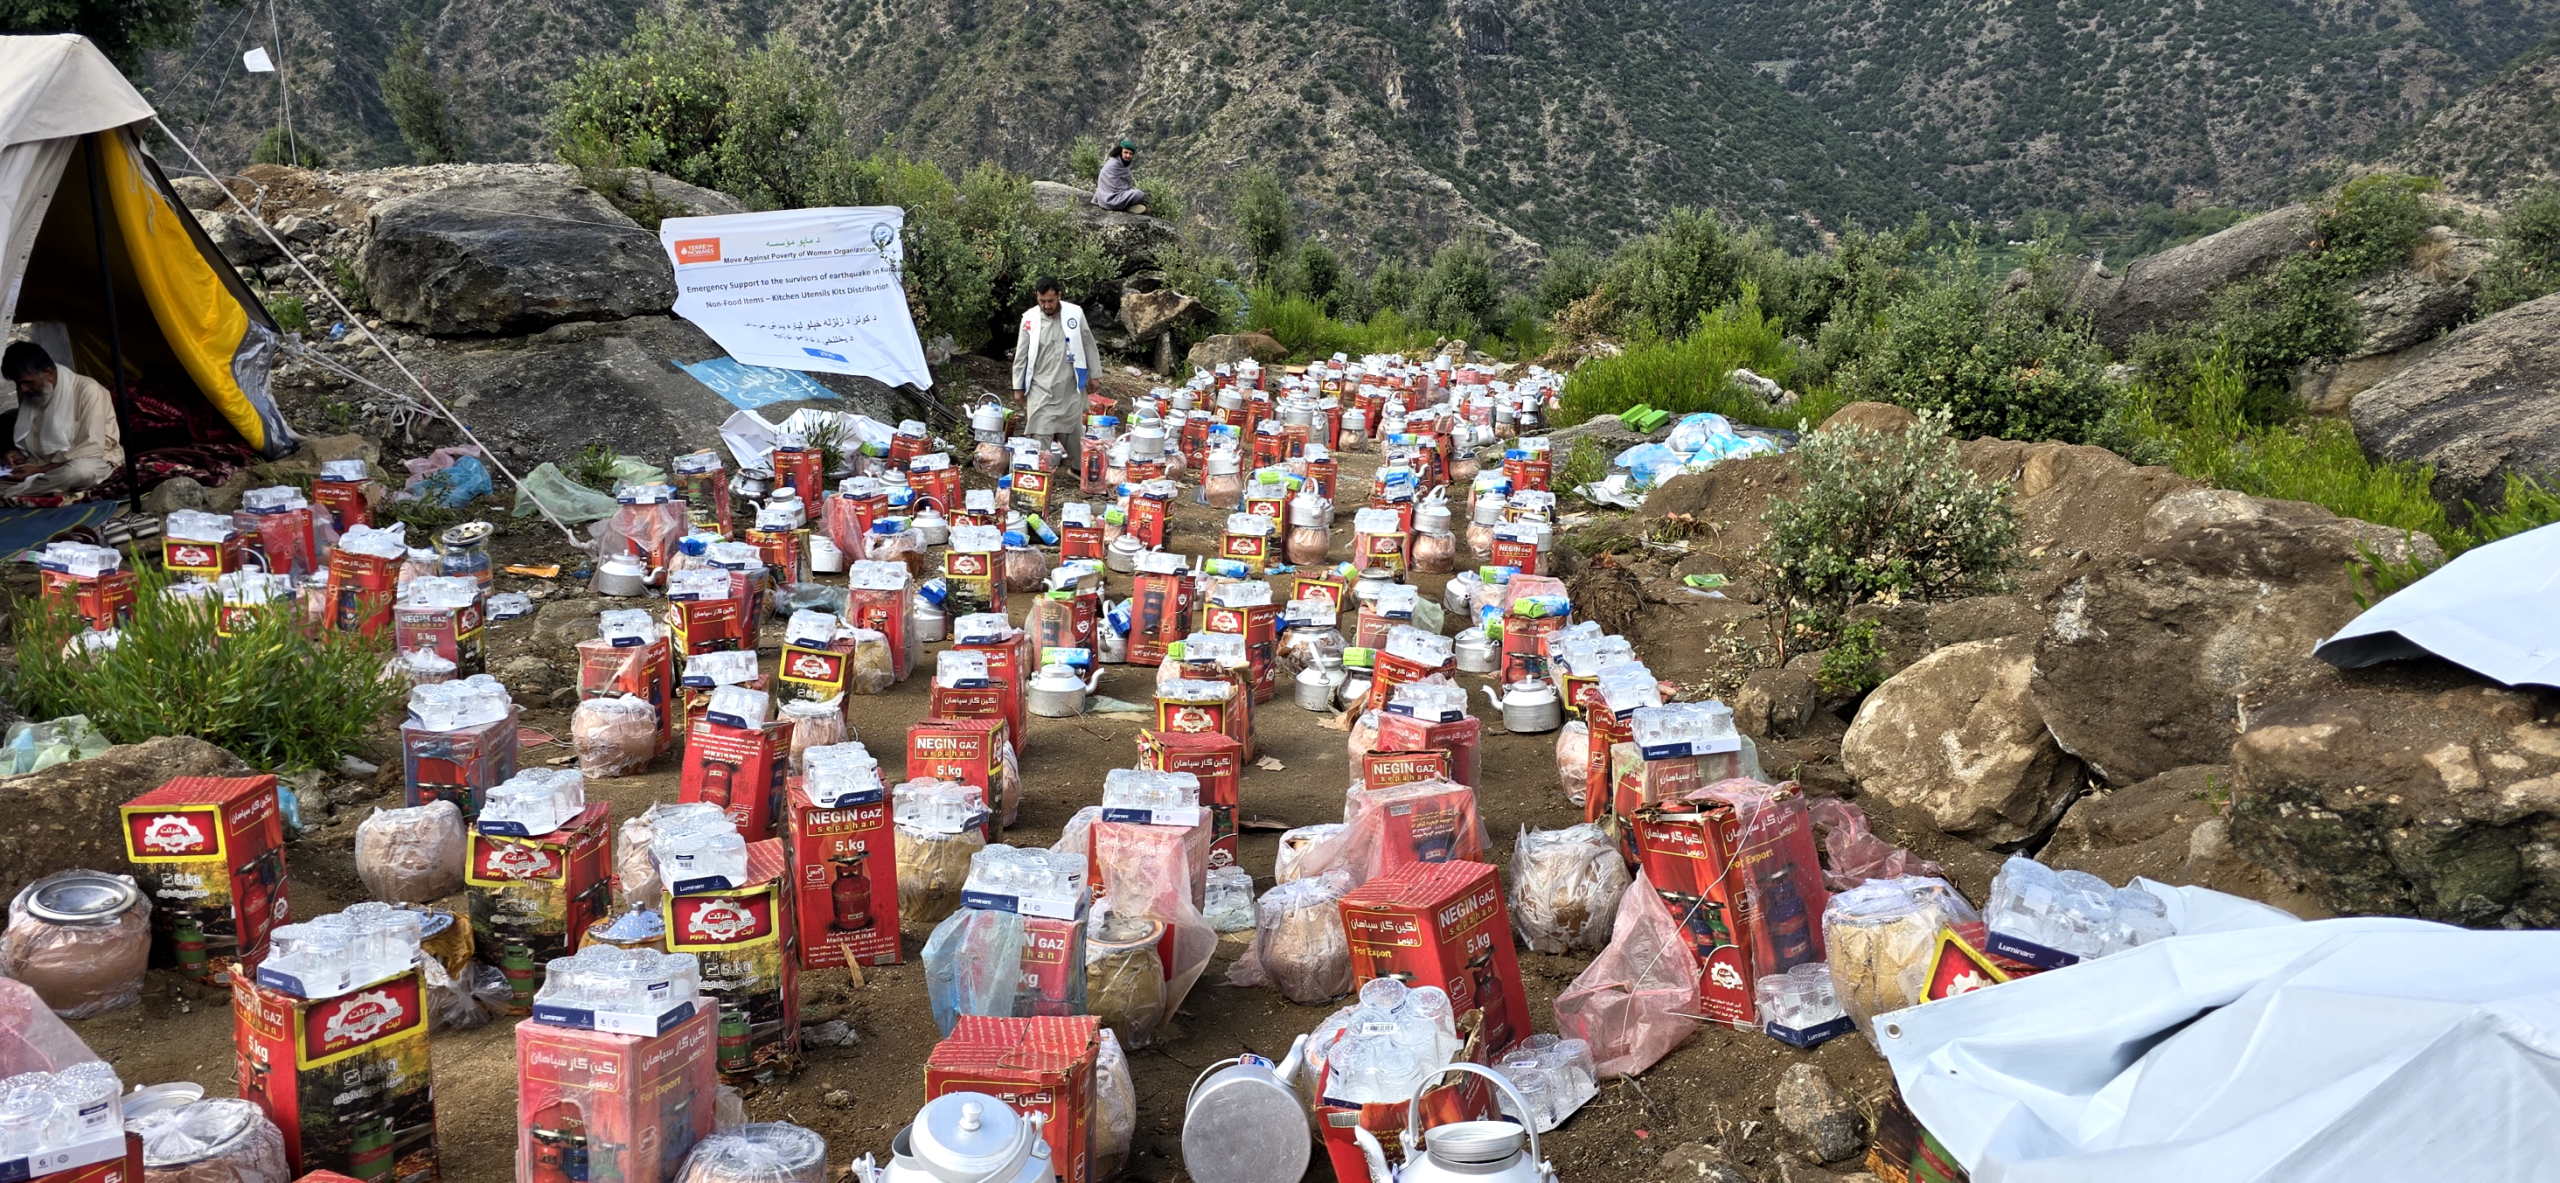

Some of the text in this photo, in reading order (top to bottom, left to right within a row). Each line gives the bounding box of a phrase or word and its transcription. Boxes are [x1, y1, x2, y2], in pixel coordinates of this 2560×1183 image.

[744, 253, 770, 263] Against
[771, 250, 797, 260] Poverty
[807, 249, 832, 257] Women
[834, 246, 876, 255] Organization
[686, 283, 728, 293] Emergency
[730, 280, 759, 290] Support
[771, 277, 783, 285] the
[785, 275, 818, 284] survivors
[829, 269, 871, 279] earthquake
[705, 298, 742, 308] Non-Food
[744, 296, 764, 305] Items
[772, 291, 800, 301] Kitchen
[801, 289, 830, 298] Utensils
[832, 288, 846, 296] Kits
[847, 283, 889, 294] Distribution
[402, 615, 430, 623] NEGIN
[871, 609, 887, 618] 5.kg
[417, 633, 437, 642] 5.kg
[944, 696, 968, 706] سپاهان
[968, 696, 980, 706] گاز
[917, 738, 978, 750] NEGIN GAZ
[923, 749, 972, 758] sepahan
[1173, 757, 1231, 769] نگین گاز سپاهان
[1374, 762, 1435, 775] NEGIN GAZ
[937, 764, 962, 777] 5.kg
[1380, 774, 1430, 783] sepahan
[1659, 772, 1690, 785] سپاهان
[809, 808, 882, 825] NEGIN GAZ
[1761, 815, 1776, 831] گاز
[161, 825, 182, 834] شرکت
[817, 820, 876, 833] sepahan
[1644, 827, 1703, 845] نگین گاز سپاهان
[835, 839, 866, 853] 5.kg
[1747, 849, 1774, 865] Export
[679, 883, 705, 893] Luminarc
[1440, 888, 1495, 928] NEGIN GAZ
[708, 911, 732, 920] شرکت
[1449, 905, 1493, 936] sepahan
[1351, 918, 1417, 934] نگین گاز سپاهان
[826, 936, 844, 944] Made
[851, 932, 877, 941] I.R.IRAN
[1038, 937, 1064, 951] GAZ
[1467, 932, 1491, 954] 5.kg
[1353, 946, 1392, 958] For Export
[1998, 942, 2035, 959] Luminarc
[721, 960, 753, 976] 5.kg
[263, 1009, 283, 1026] GAZ
[348, 1003, 377, 1019] شرکت
[540, 1012, 567, 1022] Luminarc
[1807, 1029, 1831, 1041] Luminarc
[248, 1035, 269, 1063] 5.kg
[643, 1025, 707, 1072] نگین گاز سپاهان
[530, 1051, 617, 1075] نگین گاز سپاهان
[640, 1075, 681, 1104] For Export
[1019, 1092, 1052, 1107] نگین
[39, 1158, 46, 1166] 6
